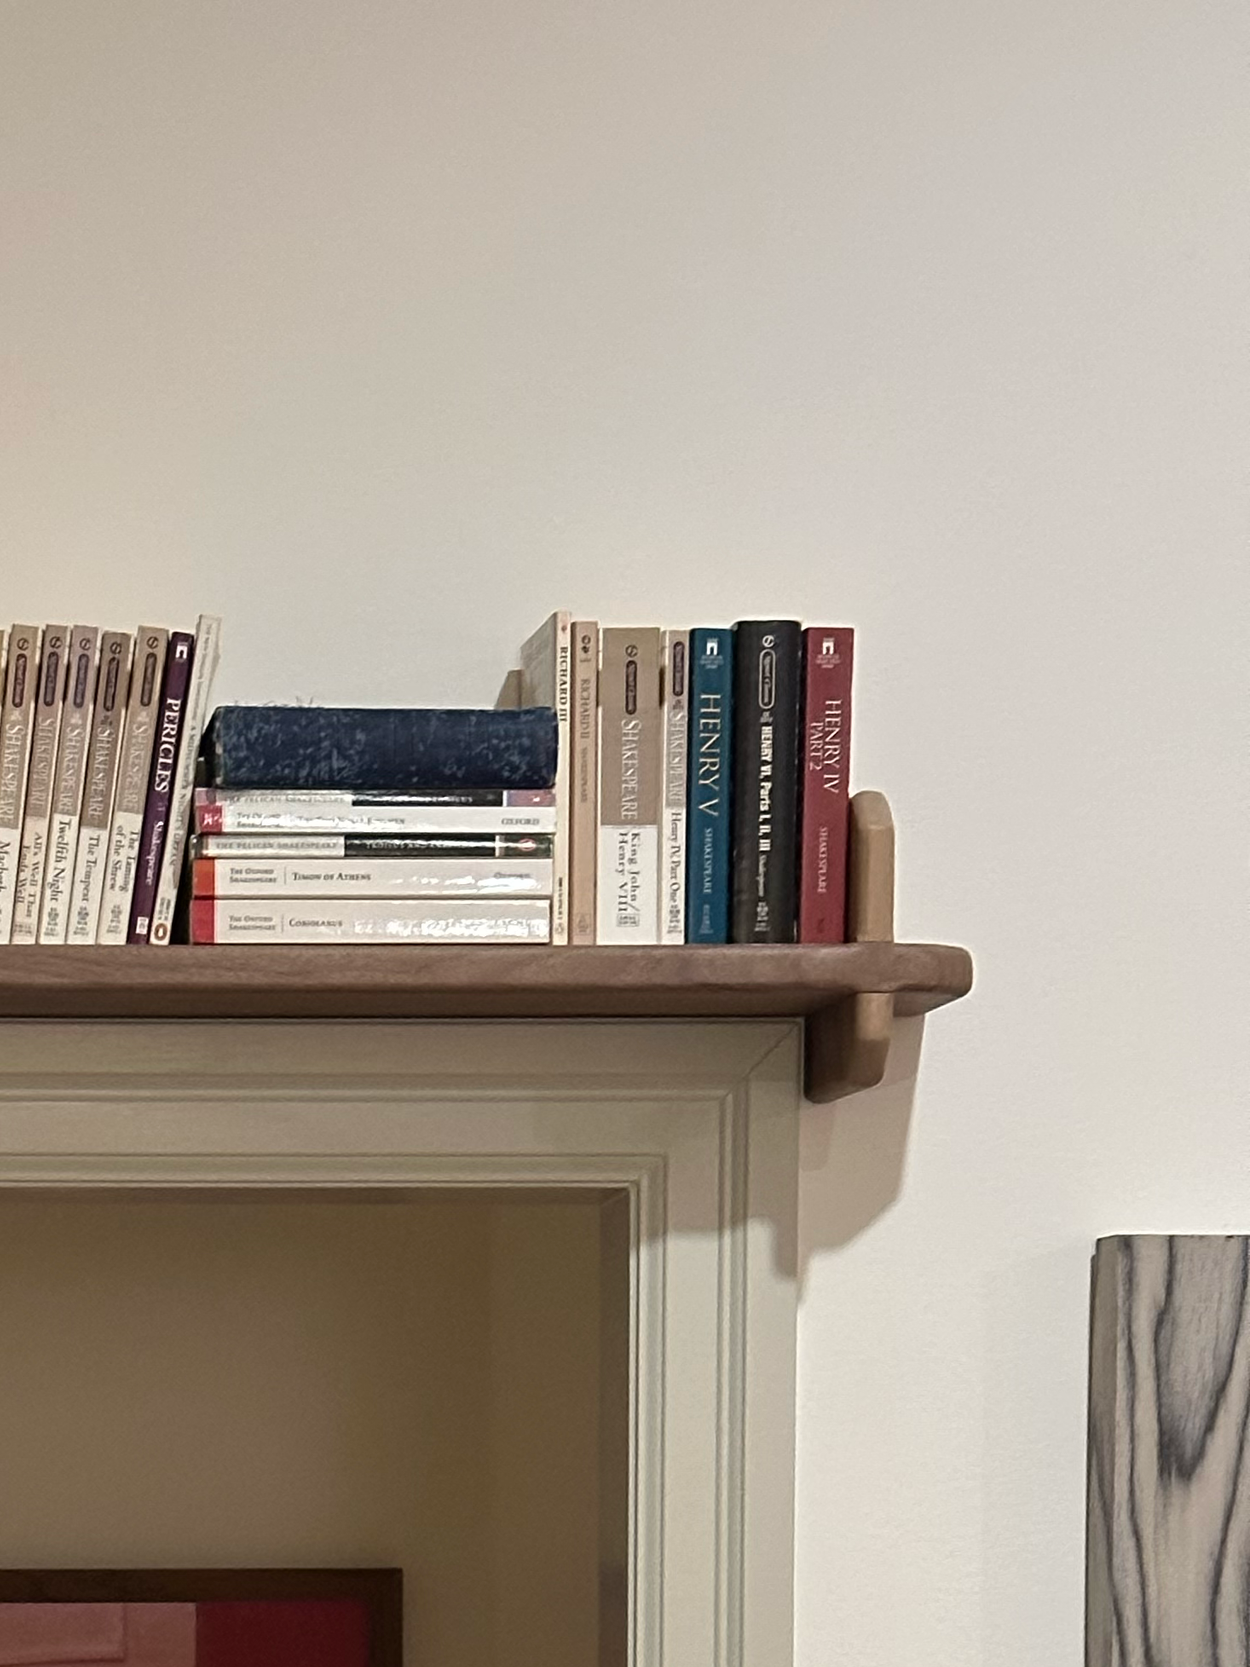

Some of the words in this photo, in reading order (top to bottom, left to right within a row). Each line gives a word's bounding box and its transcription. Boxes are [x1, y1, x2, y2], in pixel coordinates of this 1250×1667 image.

[559, 645, 569, 706] RICHARD
[559, 707, 568, 723] III
[580, 679, 590, 730] RICHARD
[154, 697, 182, 793] PERICLES
[580, 730, 589, 740] II
[698, 694, 722, 791] HENRY
[761, 724, 773, 762] HENRY
[809, 721, 823, 760] PART
[823, 699, 842, 769] HENRY
[29, 717, 55, 810] SHAKESPEARE
[52, 726, 85, 814] SHAKESPEARE
[86, 727, 116, 818] SHAKESPEARE
[118, 723, 151, 812] SHAKESPEARE
[620, 719, 642, 820] SHAKESPEARE
[669, 710, 687, 803] SHAKESPEARE
[759, 764, 772, 780] VI,
[809, 761, 821, 772] 2
[760, 781, 773, 811] Parts
[823, 773, 841, 794] IV
[501, 818, 540, 826] OXFORD
[698, 798, 720, 817] V
[758, 813, 772, 822] I,
[54, 818, 72, 864] Twelfth
[117, 825, 127, 838] of
[128, 831, 139, 852] The
[668, 811, 683, 841] Henry
[758, 824, 772, 837] II,
[88, 834, 101, 857] The
[113, 839, 125, 857] the
[146, 820, 164, 886] Shakespeare
[615, 831, 629, 877] Henry
[627, 832, 640, 865] King
[759, 838, 772, 851] III
[816, 825, 829, 893] SHAKESPEARE
[30, 860, 41, 887] Well
[110, 858, 123, 892] Shrew
[120, 855, 137, 893] Taming
[291, 871, 321, 882] TIMON
[323, 873, 334, 881] OF
[336, 871, 372, 882] ATHENS
[670, 859, 681, 880] Part
[703, 827, 714, 895] SHAKESPEARE
[17, 877, 27, 904] Well
[48, 866, 66, 903] Night
[81, 856, 98, 903] Tempest
[670, 881, 681, 904] One
[618, 881, 628, 913] VIII
[288, 918, 343, 928] CORIOLANUS
